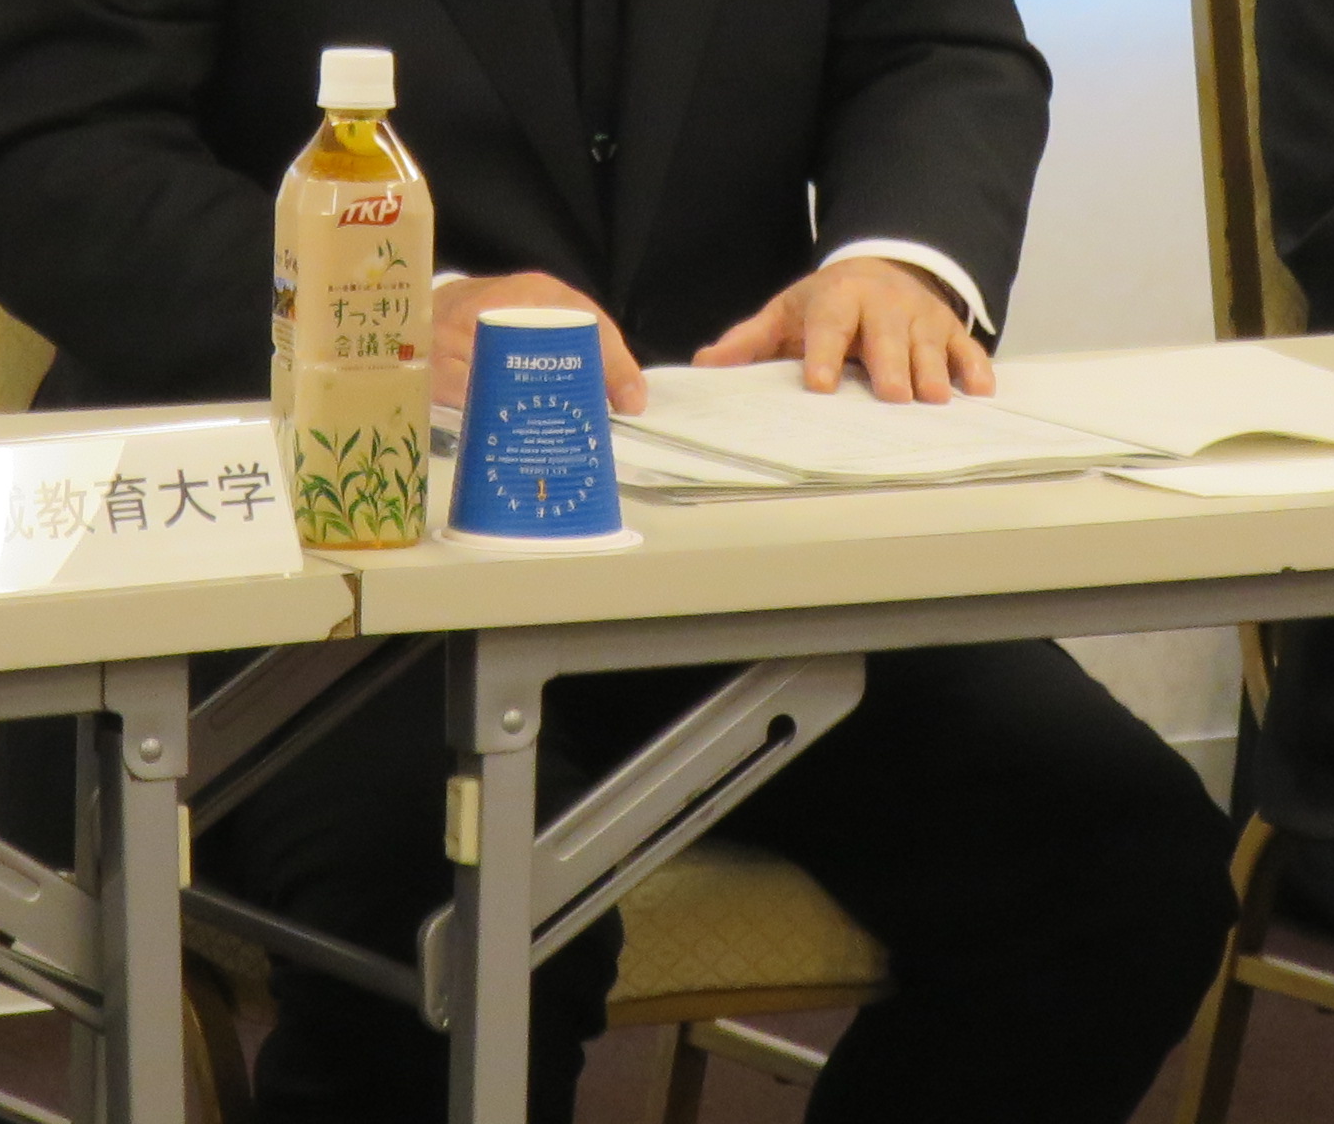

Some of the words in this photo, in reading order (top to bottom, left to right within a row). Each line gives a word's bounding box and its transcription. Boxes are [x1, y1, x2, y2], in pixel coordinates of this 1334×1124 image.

[344, 195, 400, 223] TKP
[328, 297, 410, 329] すっきり
[334, 332, 403, 358] 会議茶
